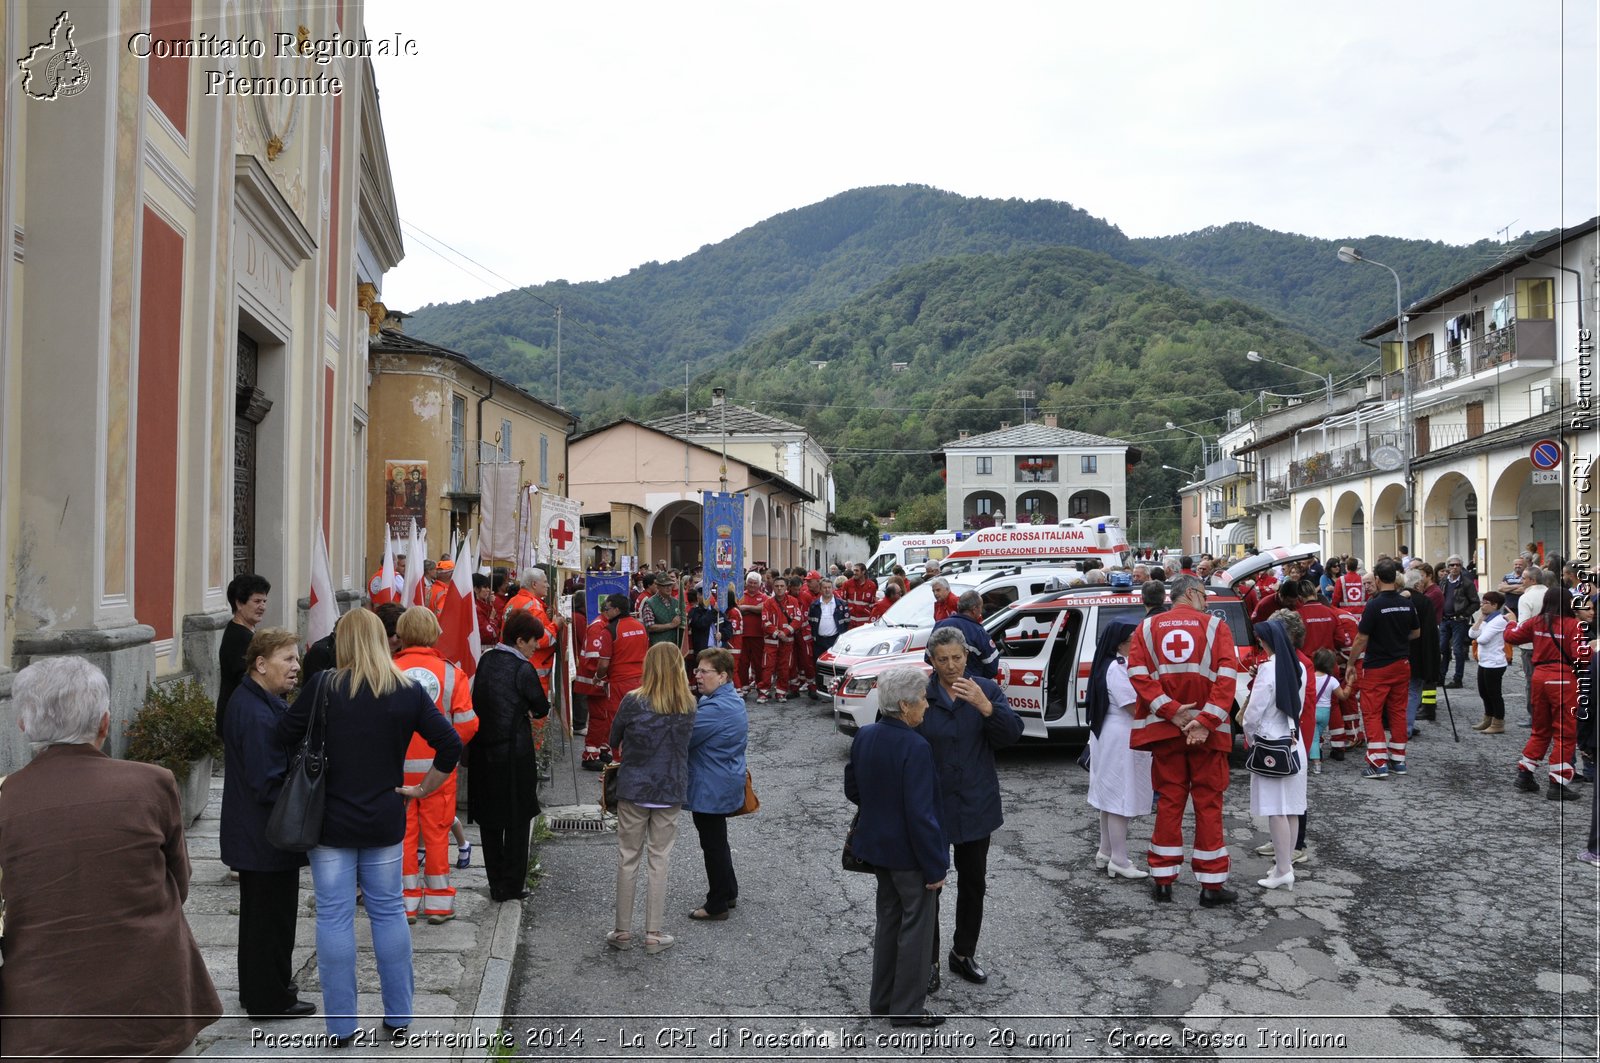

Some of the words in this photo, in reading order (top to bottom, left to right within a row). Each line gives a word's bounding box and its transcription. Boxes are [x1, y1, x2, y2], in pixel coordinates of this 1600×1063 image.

[977, 531, 1008, 543] CROCE
[1009, 531, 1041, 542] ROSSA
[1042, 531, 1085, 541] ITALIANA
[980, 547, 1037, 556] DELEGAZIONE
[1049, 546, 1089, 554] PAESANA
[1066, 597, 1129, 606] DELEGAZIONE
[1158, 620, 1171, 628] CROCE
[1183, 619, 1199, 627] ITALIANA
[1007, 697, 1041, 710] ROSSA
